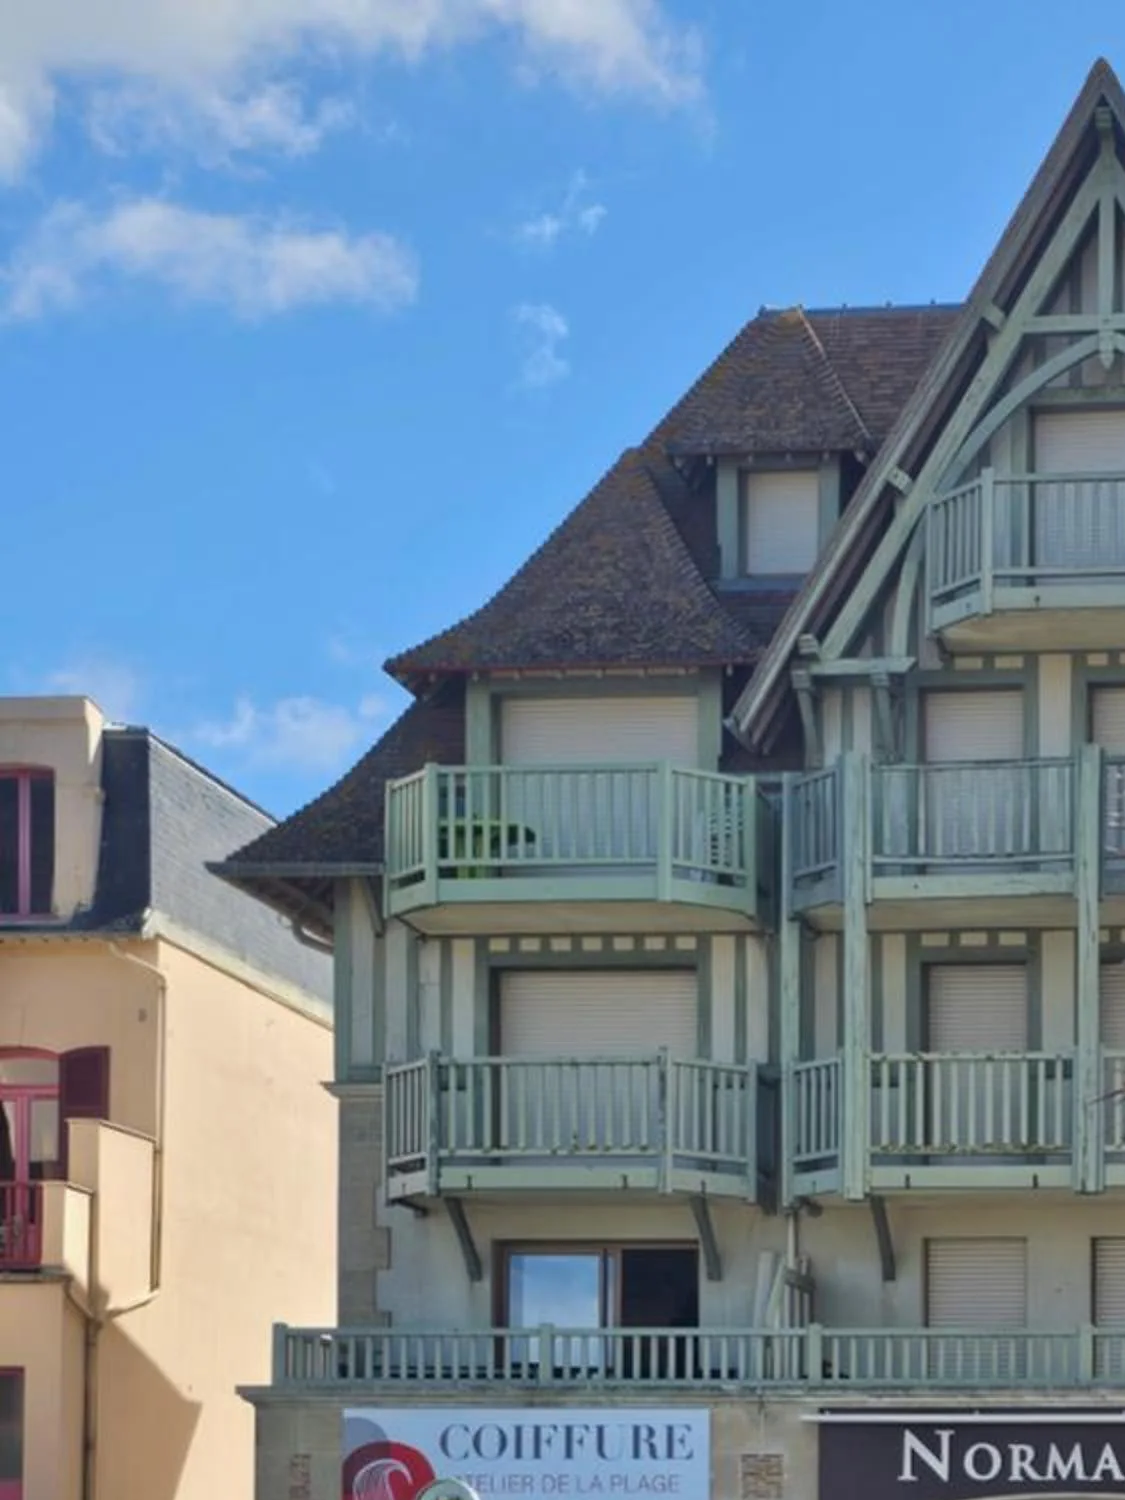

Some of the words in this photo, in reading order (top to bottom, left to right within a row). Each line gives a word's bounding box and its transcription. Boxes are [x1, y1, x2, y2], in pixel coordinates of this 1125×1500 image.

[438, 1423, 694, 1461] COIFFURE
[456, 1474, 535, 1494] TELIER
[541, 1474, 567, 1494] DE
[576, 1474, 602, 1494] LA
[609, 1474, 680, 1494] PLAGE
